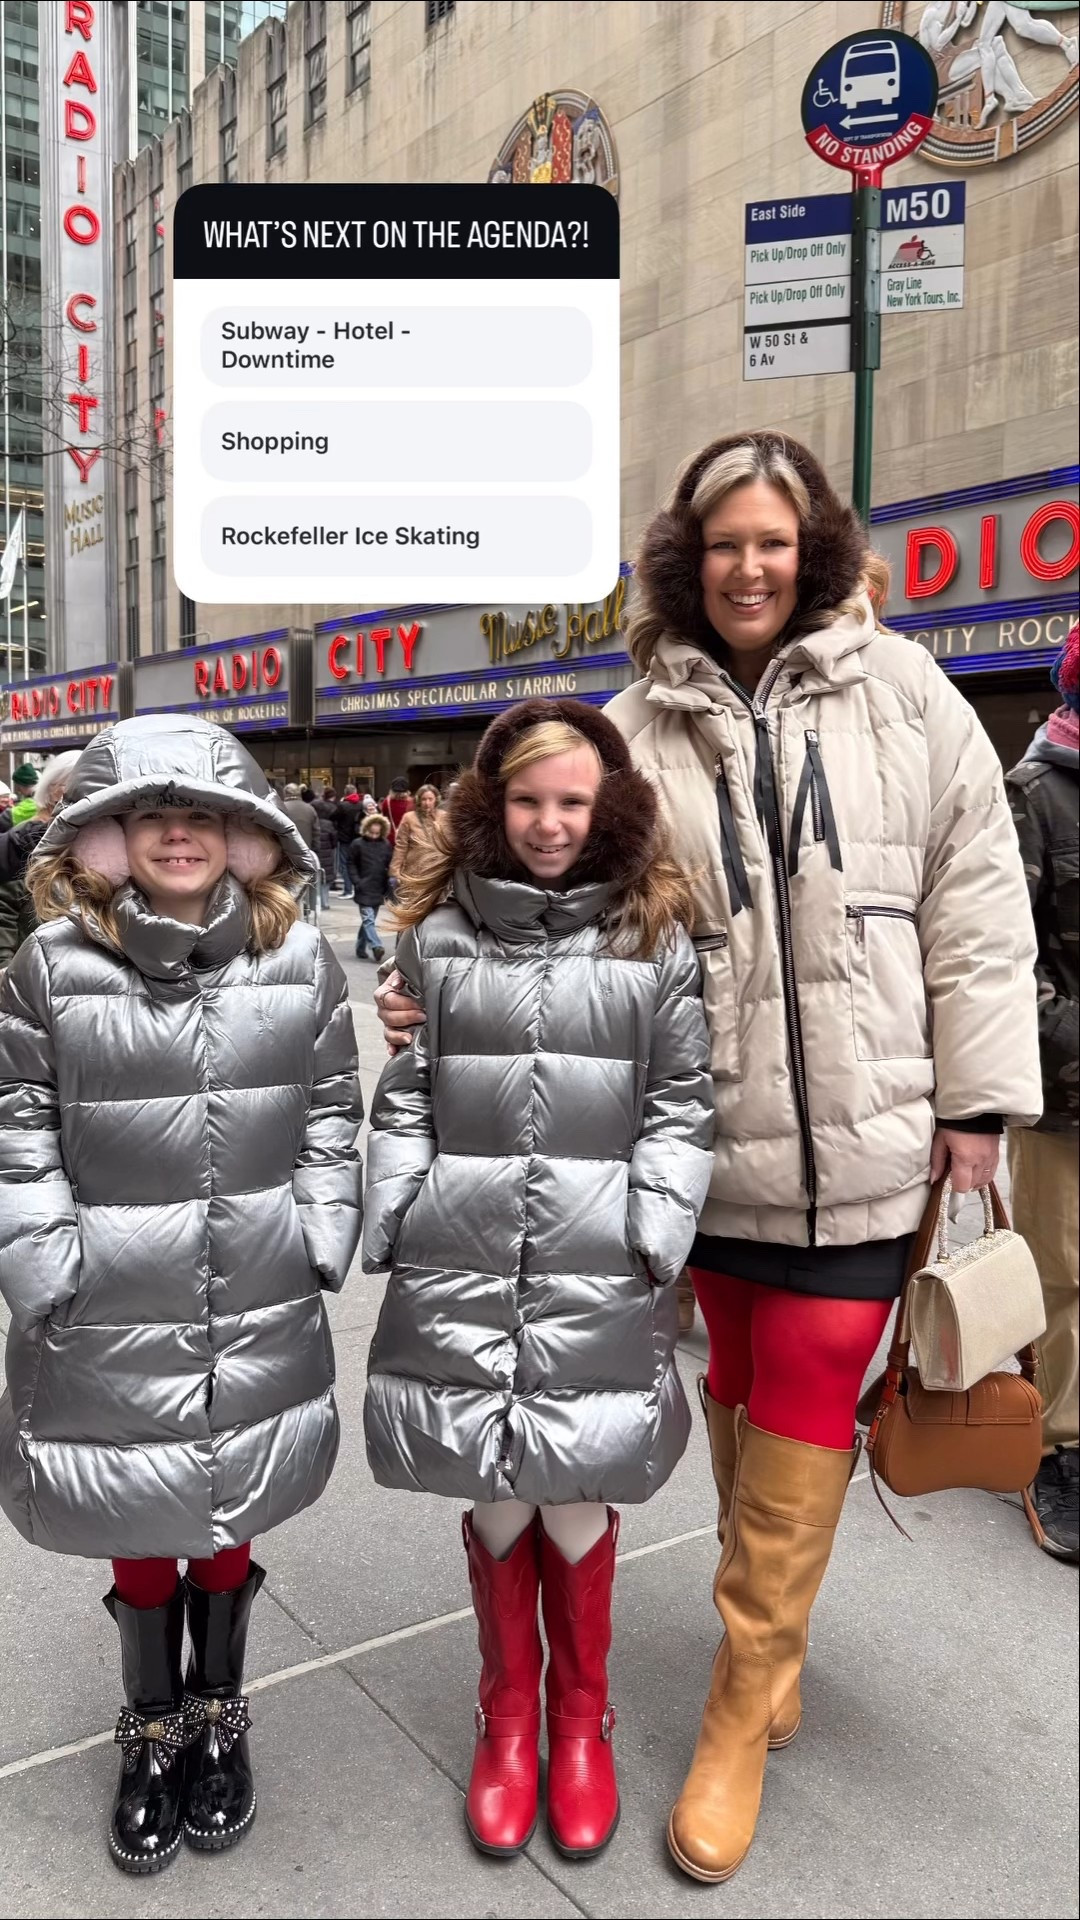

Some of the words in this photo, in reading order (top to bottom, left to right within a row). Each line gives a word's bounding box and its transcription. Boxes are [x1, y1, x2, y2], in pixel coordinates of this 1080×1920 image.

[62, 1, 101, 245] RADIO
[815, 132, 840, 156] NO
[841, 121, 922, 164] STANDING
[751, 206, 776, 222] East
[780, 204, 806, 219] Side
[887, 189, 950, 223] M50
[751, 249, 769, 263] Pick
[772, 246, 807, 263] Up/Drop
[811, 243, 824, 256] Off
[826, 242, 846, 257] Only
[888, 260, 936, 269] ACCESS-A-RIDE
[750, 291, 768, 304] Pick
[771, 288, 807, 304] Up/Drop
[810, 285, 822, 298] Off
[825, 284, 845, 298] Only
[887, 278, 904, 292] Gray
[906, 277, 922, 290] Line
[887, 294, 903, 307] New
[905, 292, 921, 306] York
[923, 292, 945, 304] Tours,
[947, 290, 960, 302] Inc.
[750, 336, 761, 348] W
[765, 334, 779, 348] 50
[784, 333, 796, 345] St
[800, 332, 808, 344] &
[750, 355, 756, 366] 6
[760, 354, 775, 366] Av
[66, 293, 101, 483] CITY
[64, 494, 104, 530] MUSIC
[71, 523, 104, 556] HALL
[905, 501, 1079, 599] DIO
[328, 620, 421, 680] CITY
[480, 604, 558, 663] Music
[194, 646, 281, 696] RADIO
[11, 686, 58, 721] RADIO
[67, 674, 112, 714] CITY
[341, 692, 400, 712] CHRISTMAS
[407, 682, 497, 707] SPECTACULAR
[506, 673, 577, 698] STARRING
[224, 708, 233, 721] OF
[238, 704, 286, 720] ROCKETTES
